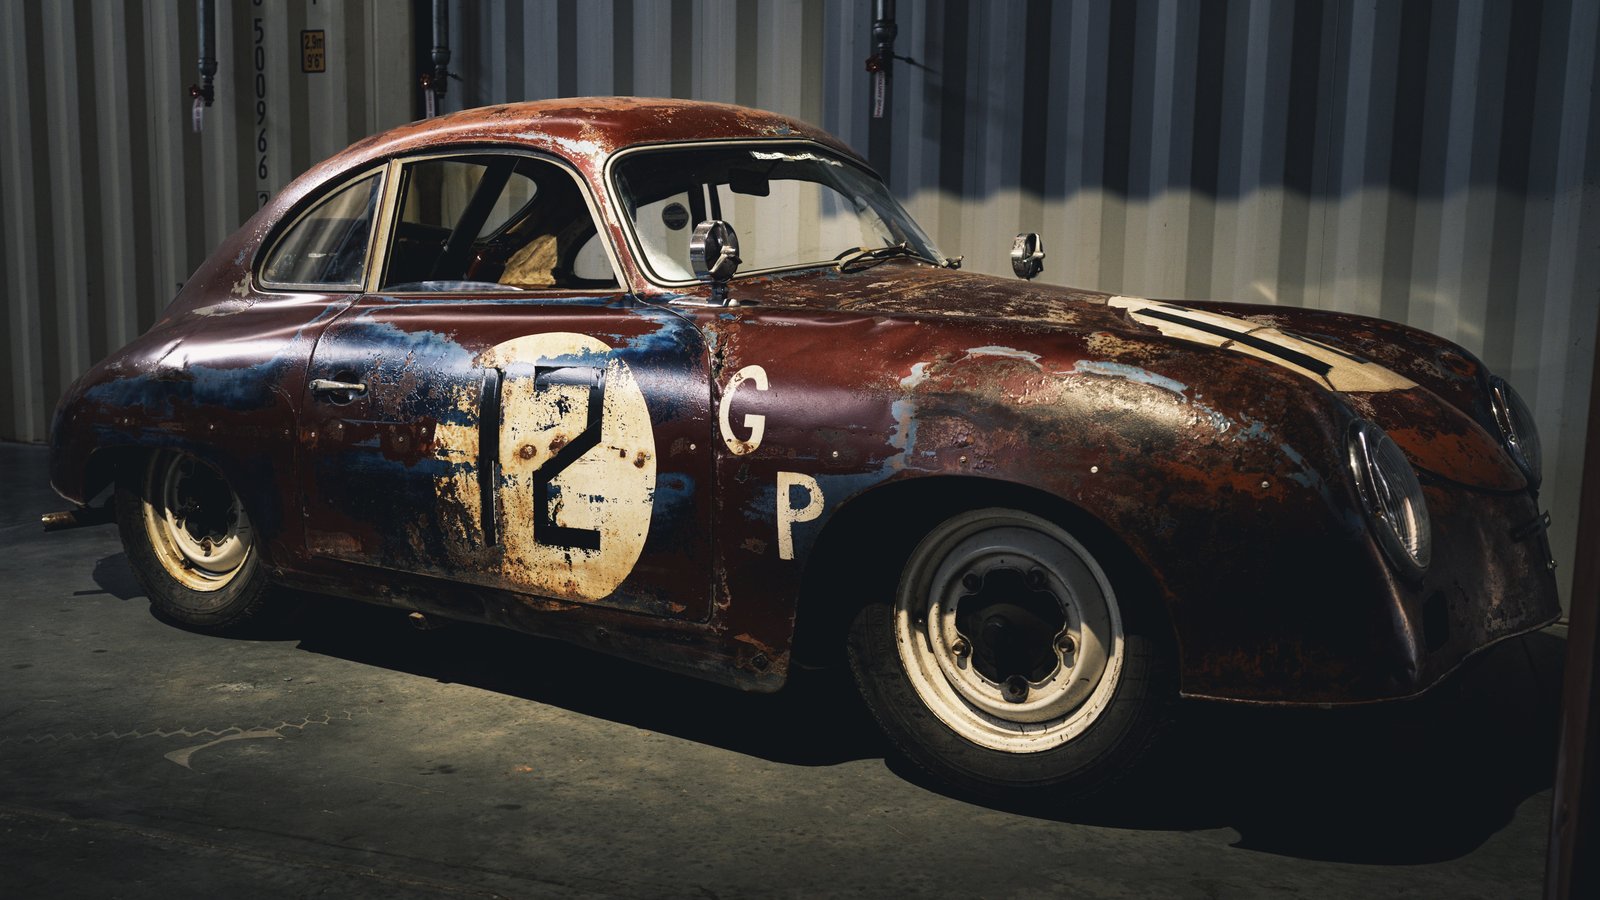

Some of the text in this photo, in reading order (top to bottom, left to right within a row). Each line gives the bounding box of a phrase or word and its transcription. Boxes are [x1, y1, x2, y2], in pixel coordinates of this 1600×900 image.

[719, 364, 769, 456] G
[480, 363, 607, 550] 12
[776, 471, 825, 560] P
